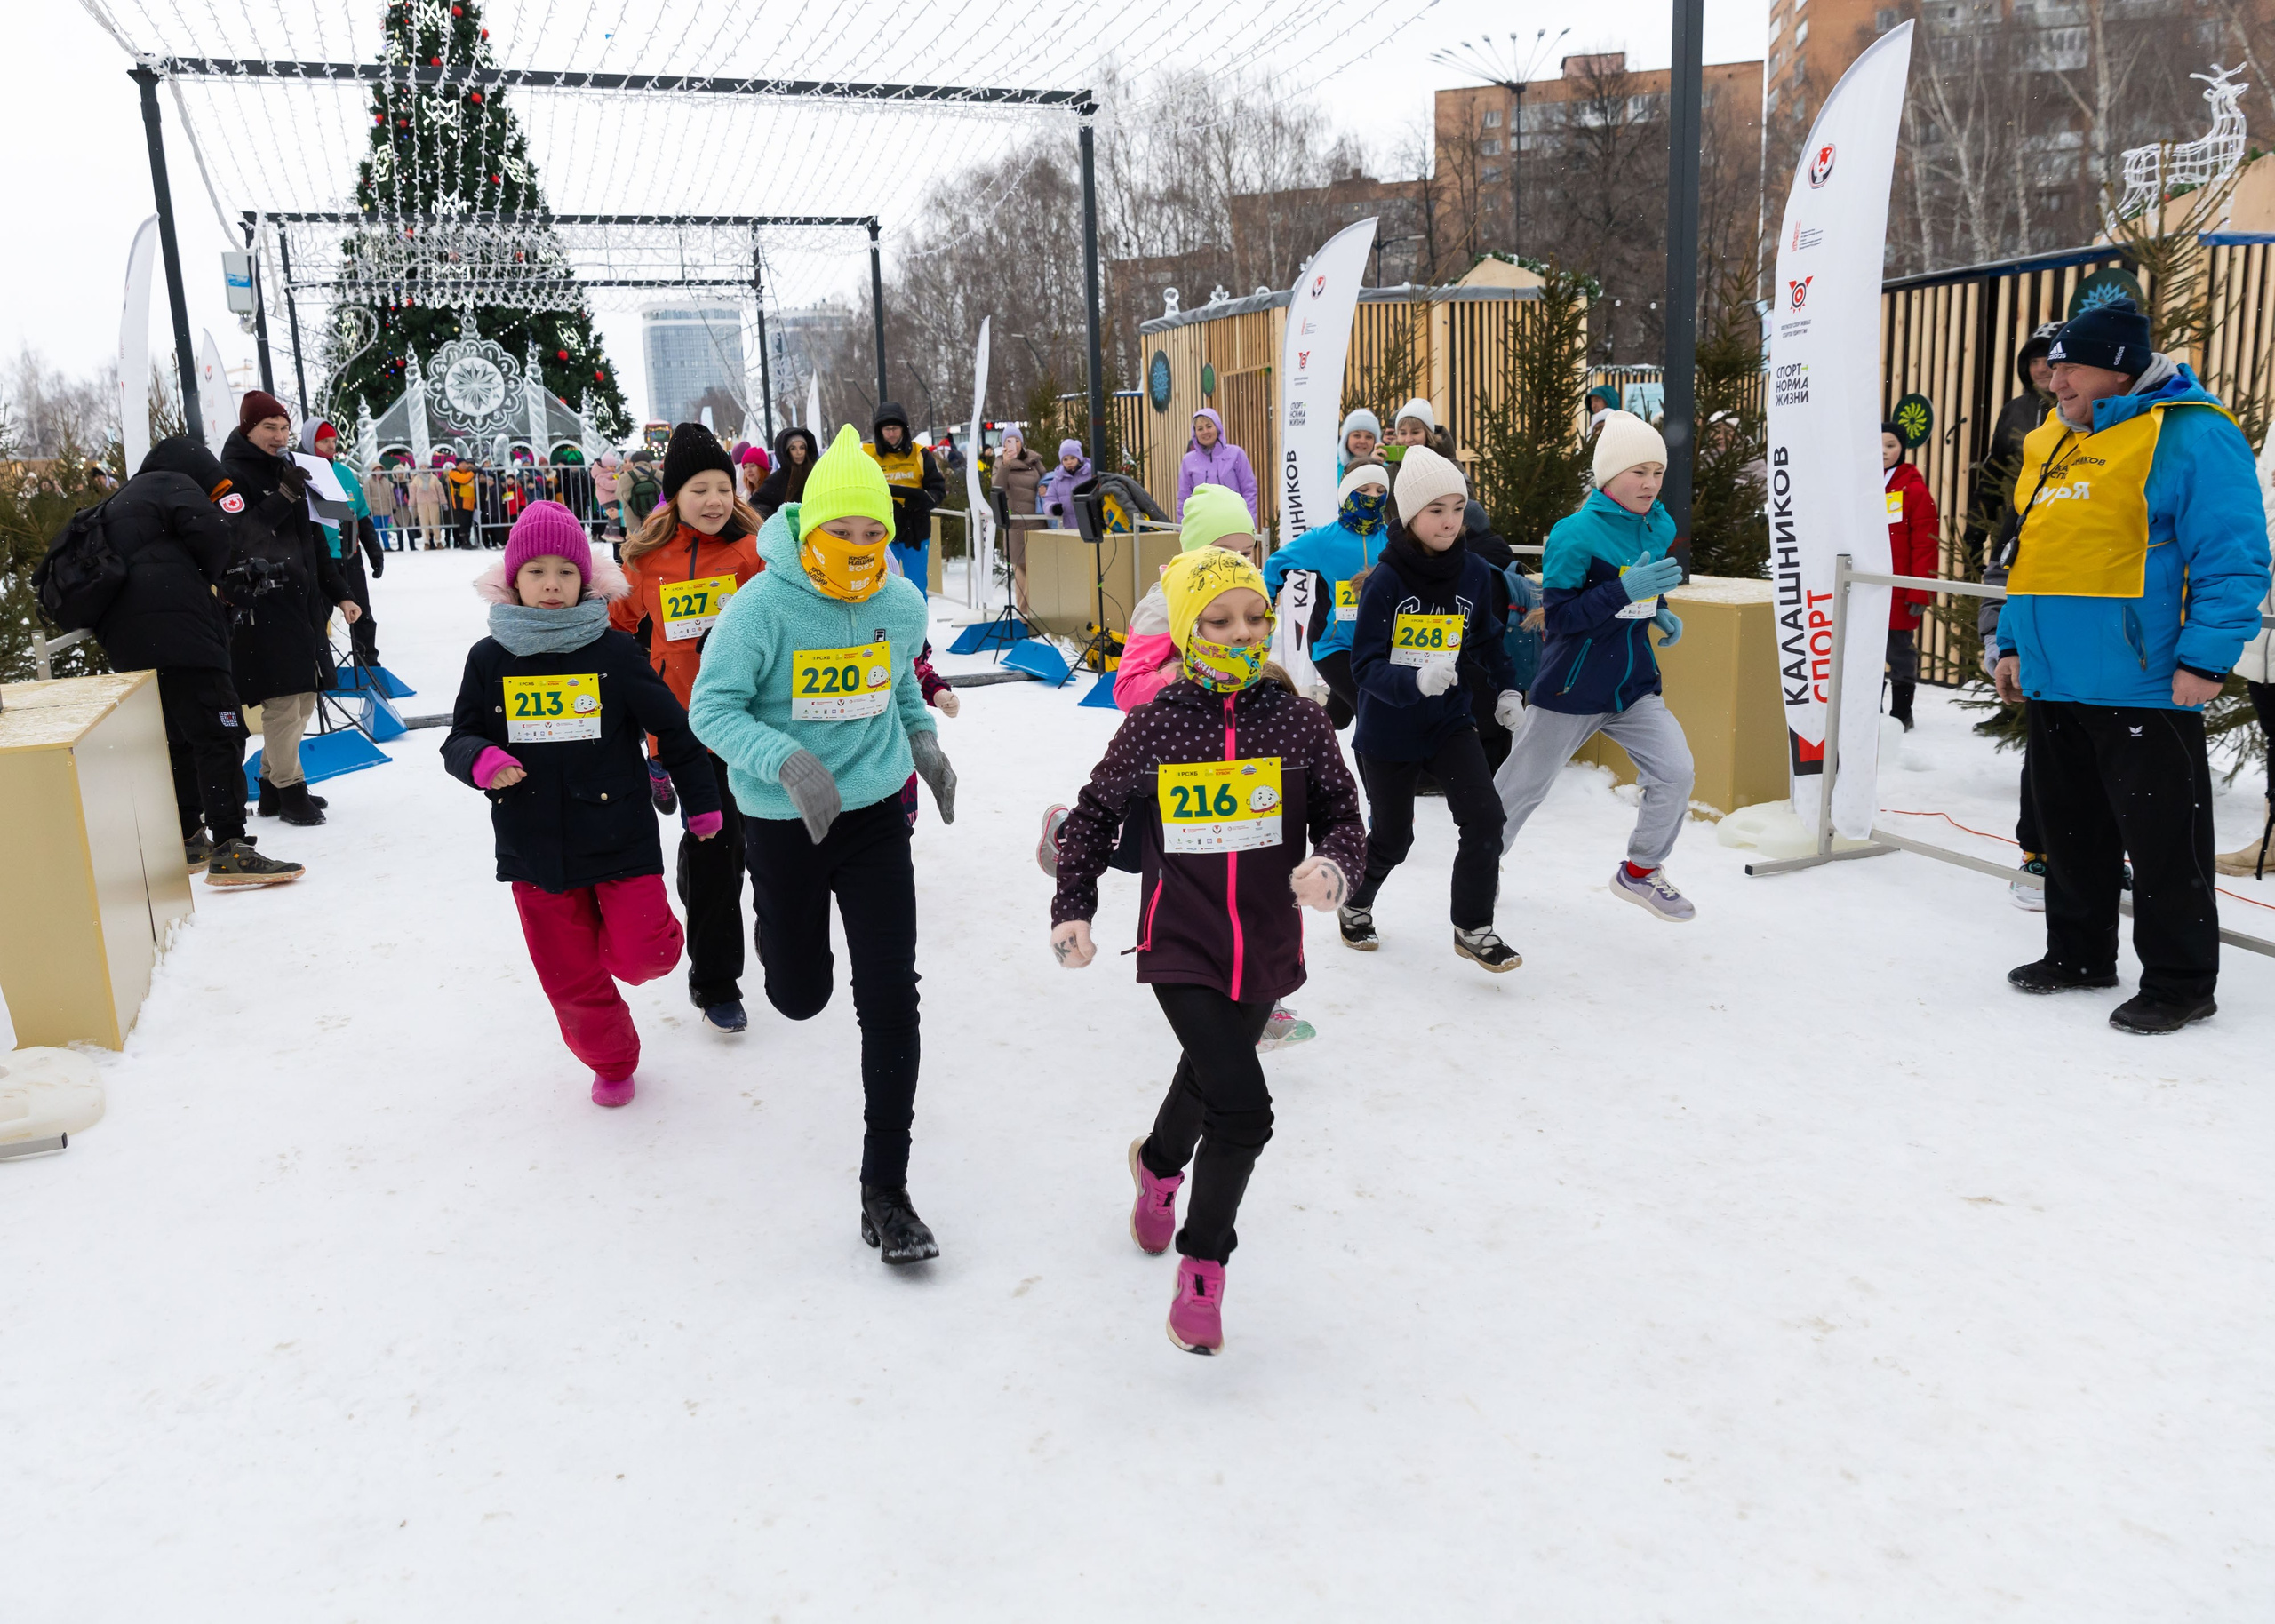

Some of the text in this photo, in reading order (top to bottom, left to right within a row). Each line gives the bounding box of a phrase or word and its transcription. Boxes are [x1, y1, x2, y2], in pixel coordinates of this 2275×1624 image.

[1776, 363, 1801, 378] СПОРТ
[1776, 377, 1808, 394] НОРМА
[1775, 391, 1809, 407] ЖИЗНИ
[1286, 450, 1308, 608] КАНИКОВ
[848, 561, 874, 572] 2023
[1773, 446, 1810, 706] КАЛАШНИКОВ
[667, 592, 709, 618] 227
[1399, 626, 1443, 649] 268
[1806, 589, 1834, 704] СПОРТ
[801, 665, 860, 694] 220
[515, 691, 563, 717] 213
[1169, 783, 1238, 818] 216
